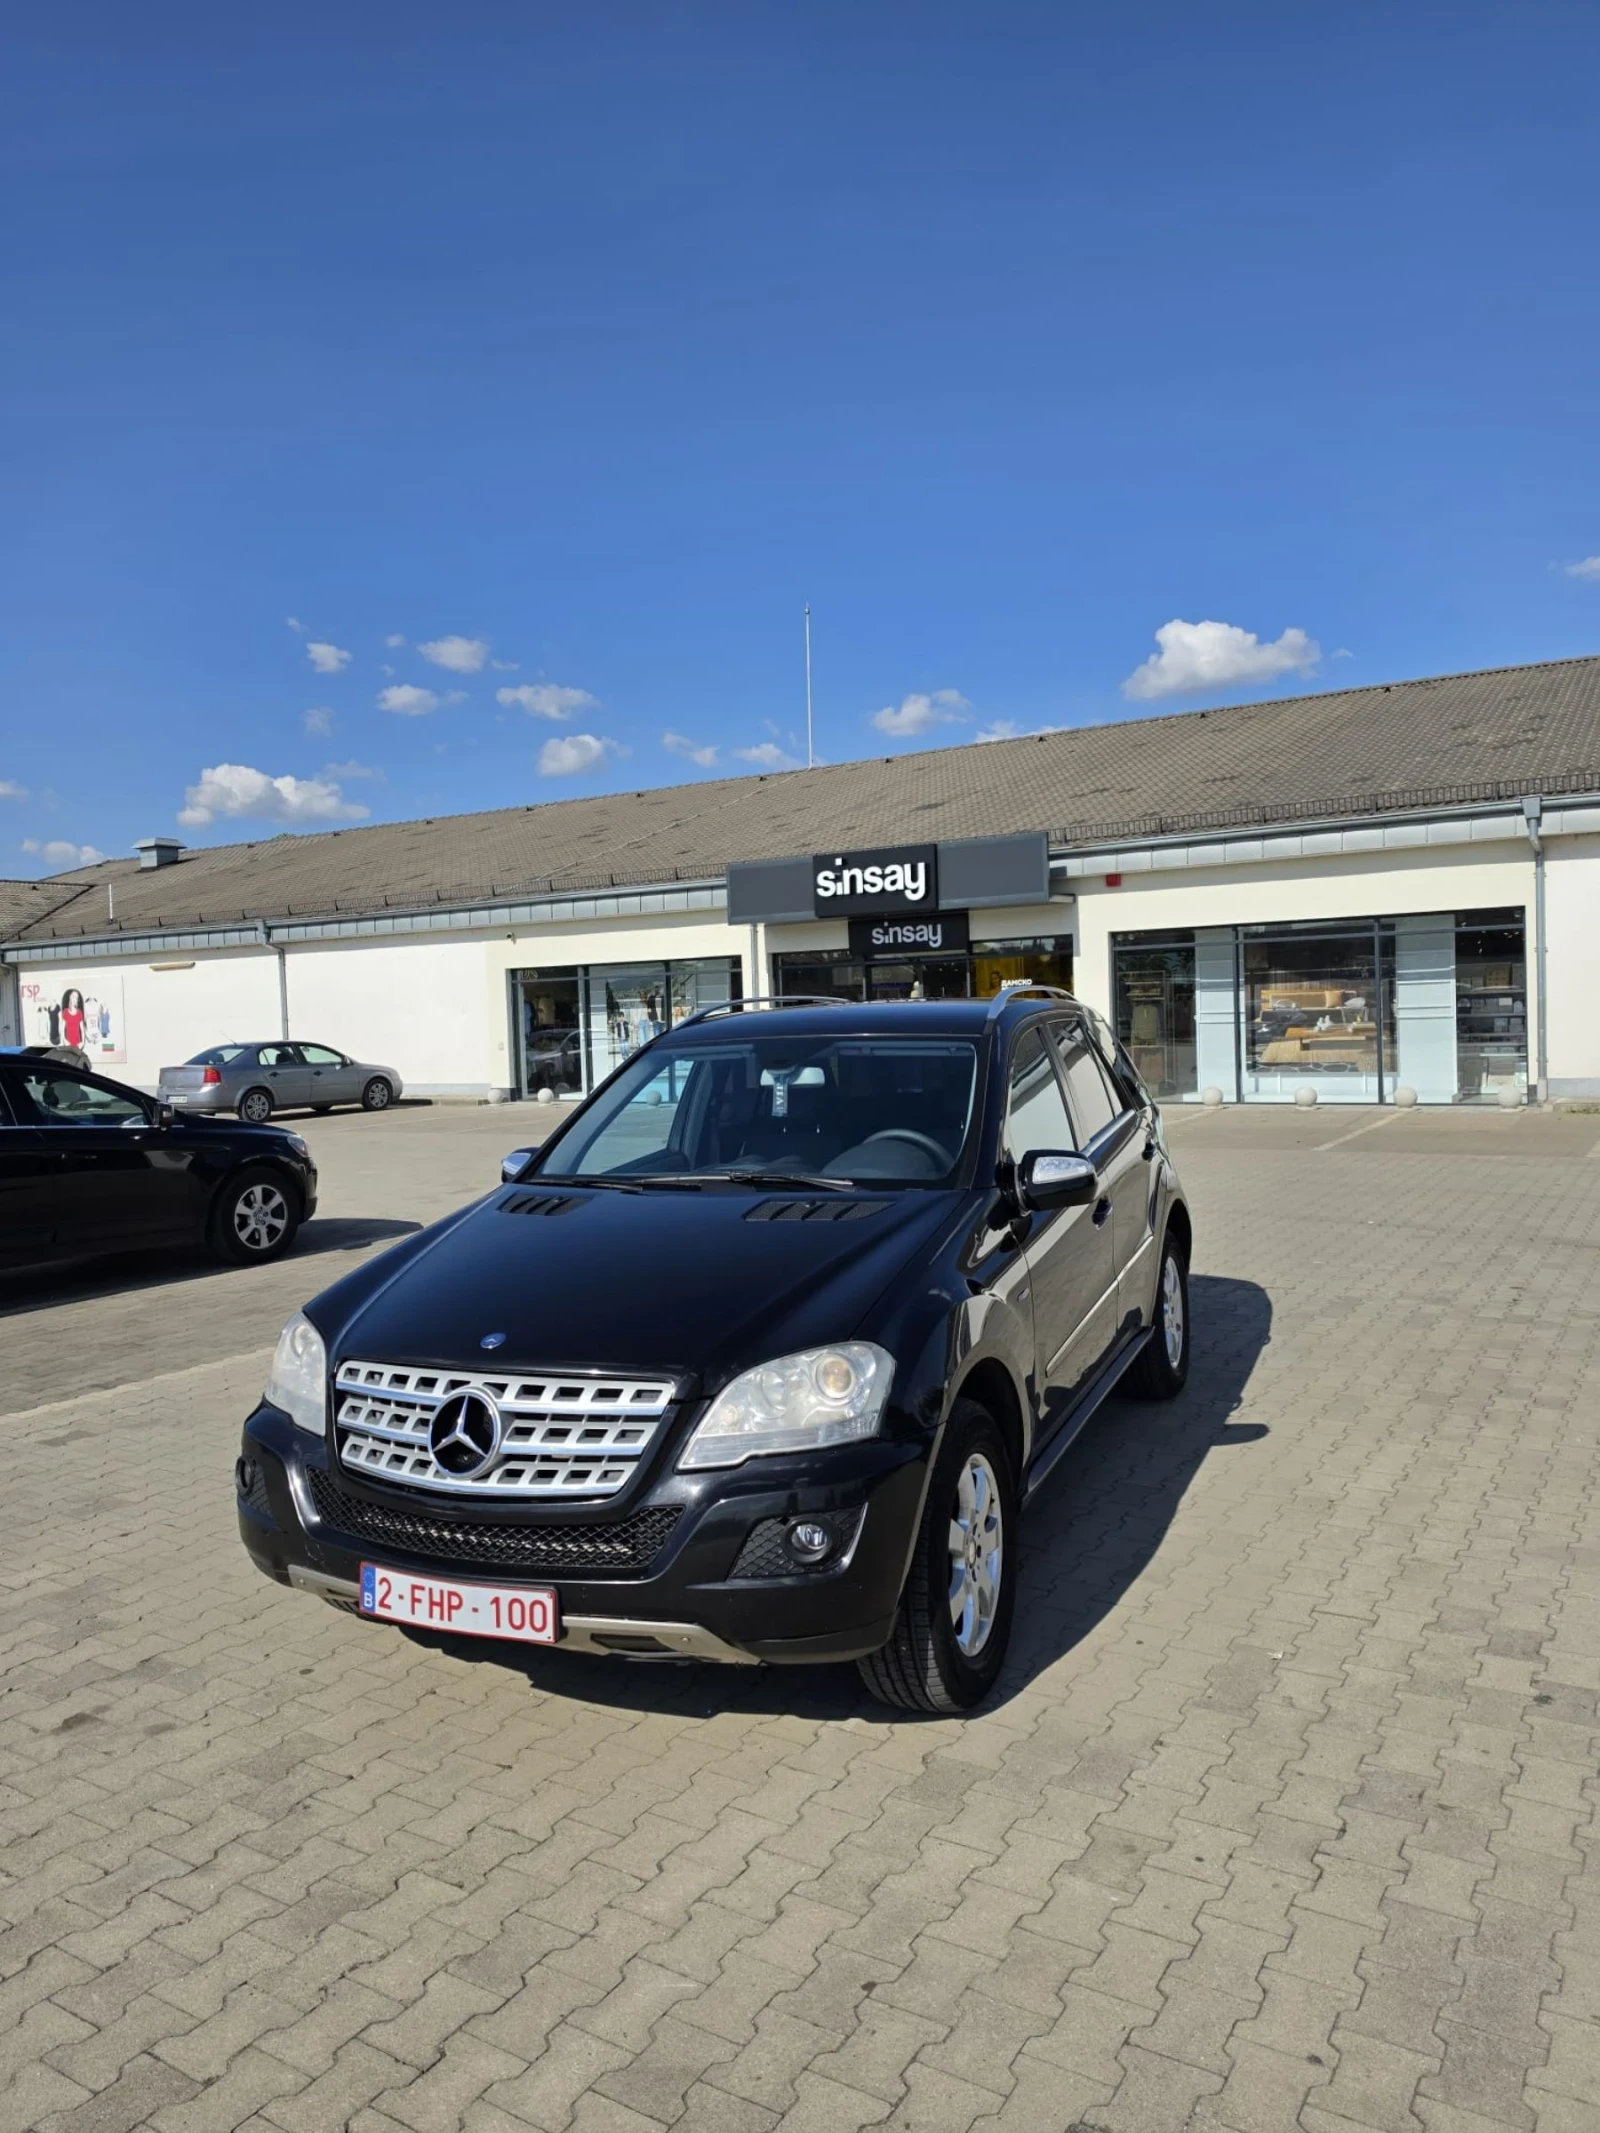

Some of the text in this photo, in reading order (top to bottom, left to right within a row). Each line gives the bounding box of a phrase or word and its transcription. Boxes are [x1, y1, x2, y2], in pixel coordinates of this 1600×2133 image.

[816, 857, 926, 901] sinsay
[871, 921, 943, 948] sinsay
[363, 1591, 374, 1608] B
